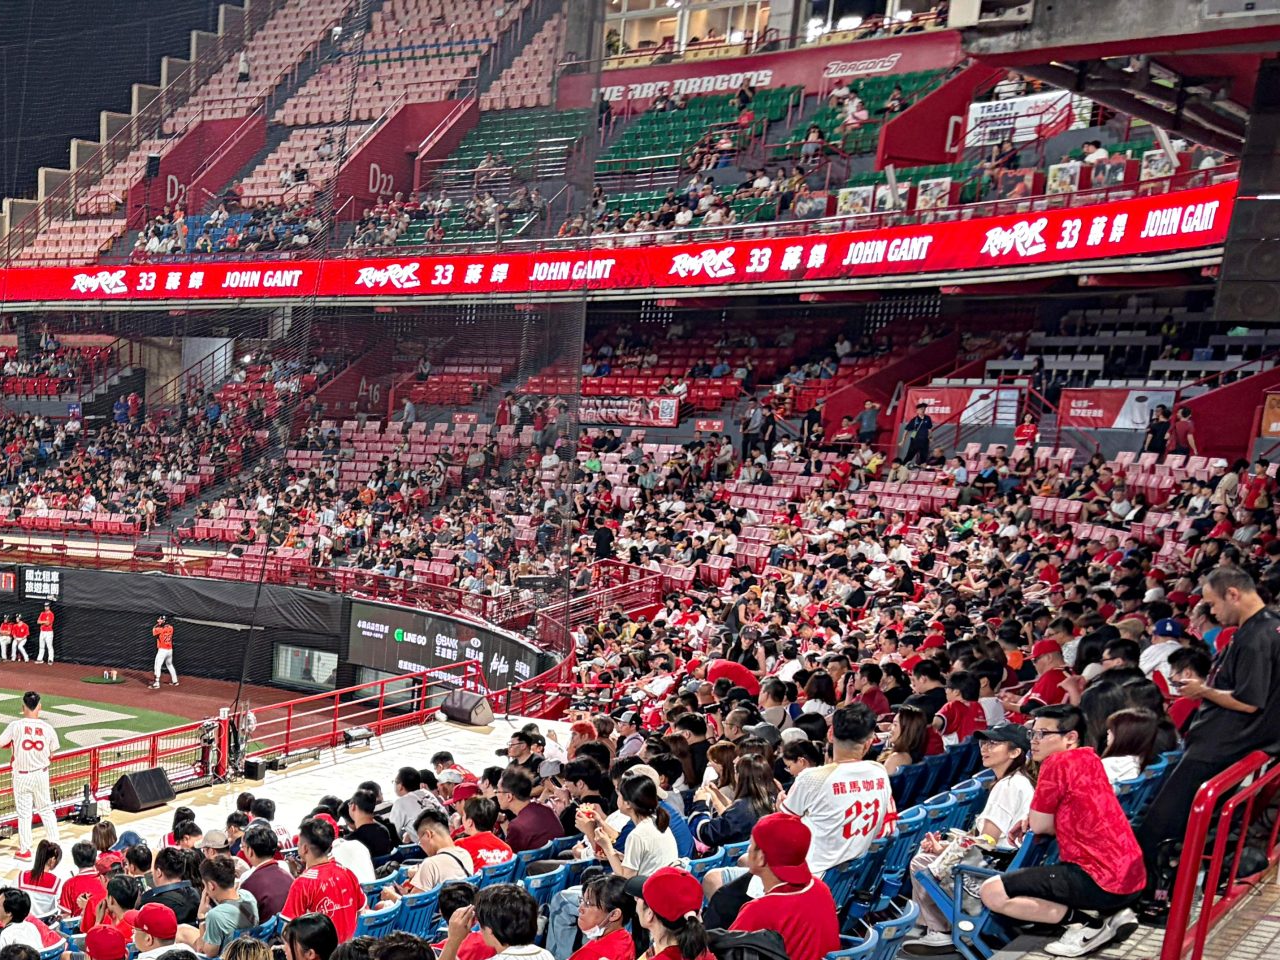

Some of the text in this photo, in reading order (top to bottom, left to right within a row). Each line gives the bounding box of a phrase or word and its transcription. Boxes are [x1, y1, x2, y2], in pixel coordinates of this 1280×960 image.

[980, 101, 1016, 115] TREAT
[369, 163, 395, 196] D22
[1056, 218, 1082, 249] 33
[1140, 206, 1183, 238] JOHN
[1180, 200, 1220, 234] GANT
[745, 247, 772, 273] 33
[841, 239, 887, 266] JOHN
[887, 235, 934, 262] GANT
[136, 271, 157, 291] 33
[221, 270, 262, 289] JOHN
[262, 269, 304, 288] GANT
[431, 264, 454, 285] 33
[529, 260, 571, 282] JOHN
[571, 258, 617, 280] GANT
[832, 777, 886, 796] 龍馬咖豪
[841, 798, 880, 840] 23
